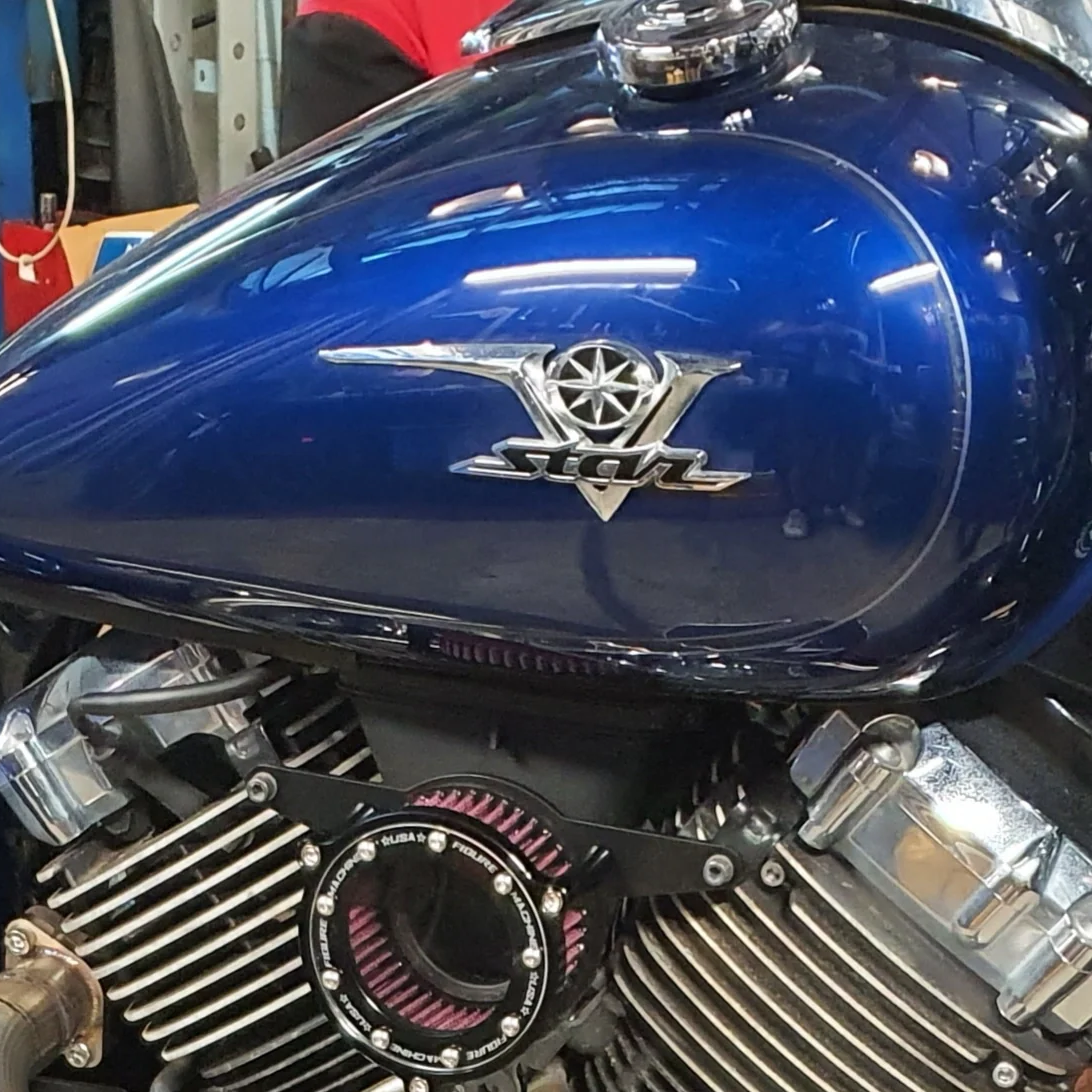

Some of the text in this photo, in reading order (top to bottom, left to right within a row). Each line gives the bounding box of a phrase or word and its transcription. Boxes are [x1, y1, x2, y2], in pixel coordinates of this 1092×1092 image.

[319, 918, 332, 969] FIGURE
[389, 833, 416, 844] USA
[451, 840, 499, 875] FIGURE
[523, 982, 538, 1007] USA
